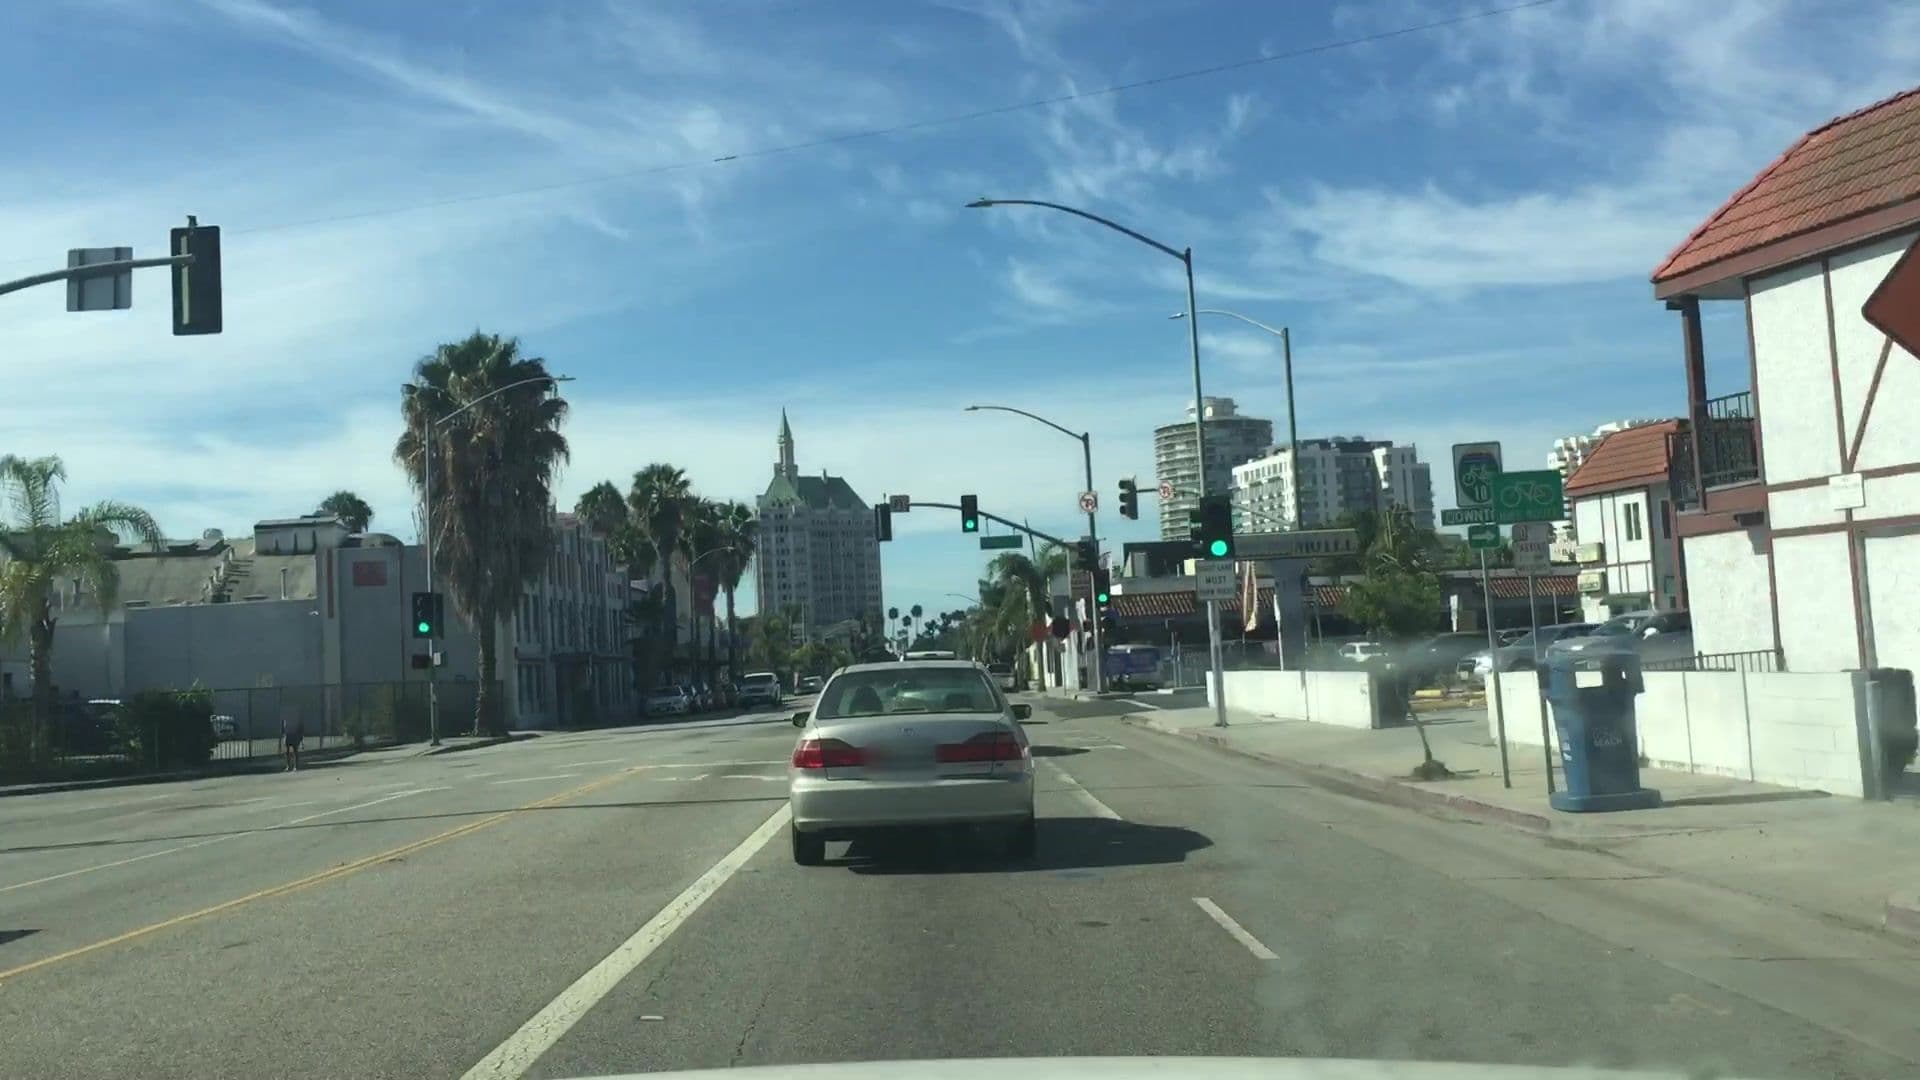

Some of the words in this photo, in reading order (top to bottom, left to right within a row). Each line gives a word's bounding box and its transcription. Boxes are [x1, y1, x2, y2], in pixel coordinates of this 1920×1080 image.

[1474, 485, 1488, 501] 10
[1445, 509, 1494, 524] DOWNT
[1205, 575, 1226, 585] MUST
